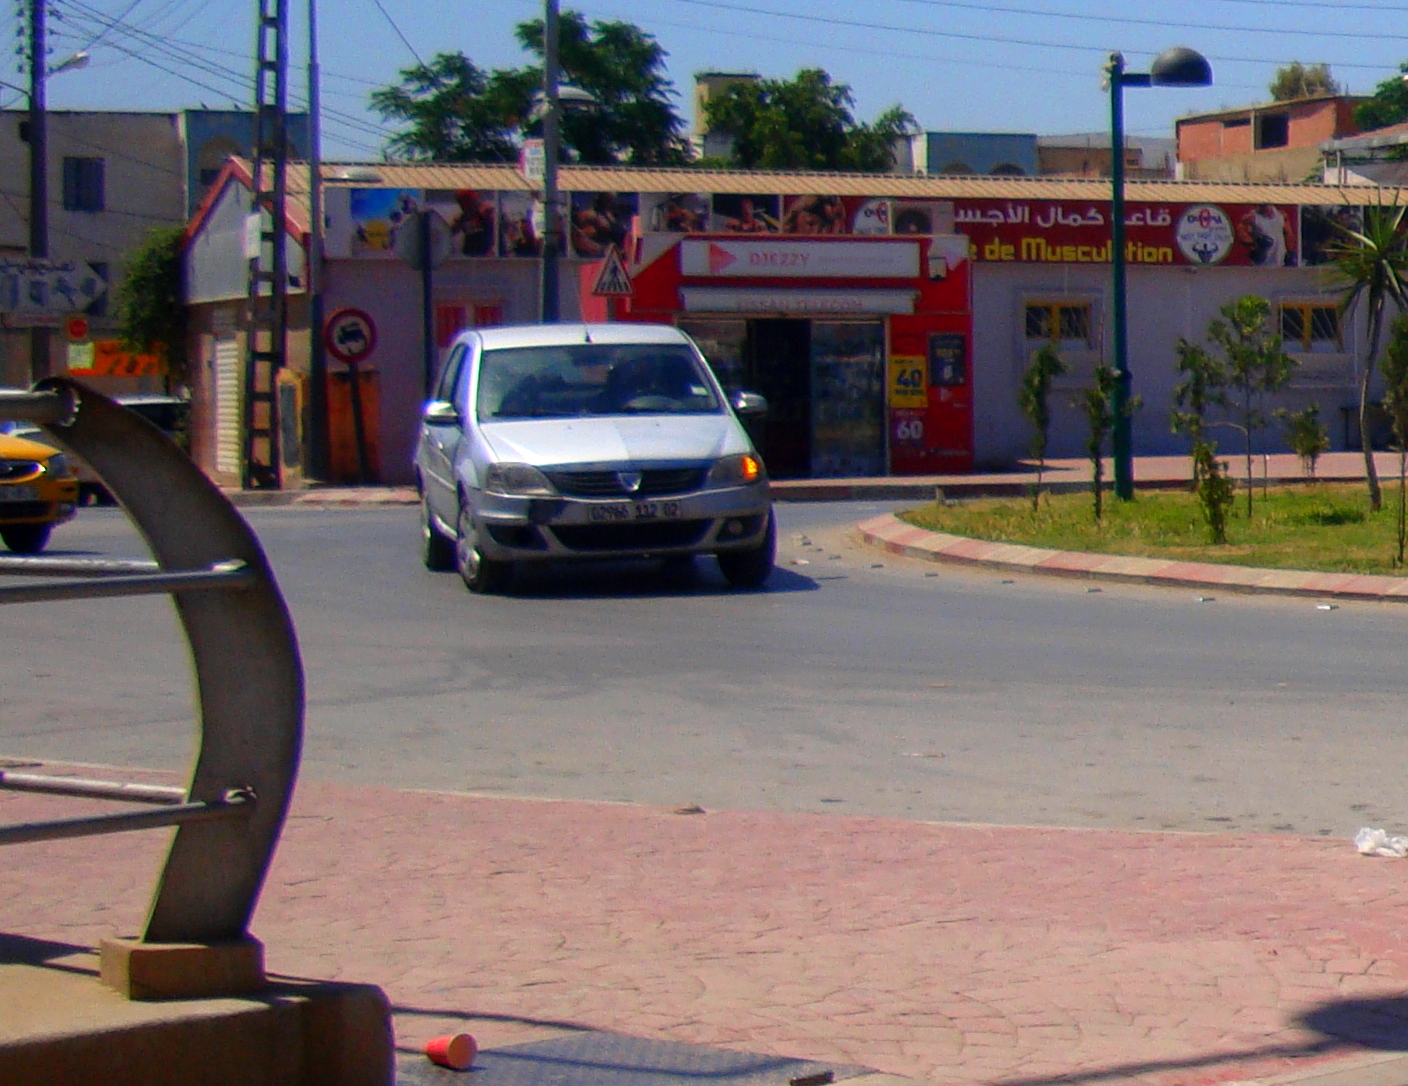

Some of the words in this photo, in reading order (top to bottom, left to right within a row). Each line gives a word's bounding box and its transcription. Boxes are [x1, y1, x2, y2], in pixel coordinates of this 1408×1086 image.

[954, 202, 1030, 227] الأجس
[1036, 205, 1105, 229] كمال
[1111, 205, 1172, 227] قاع
[984, 235, 1015, 261] de
[1021, 236, 1174, 263] Muscultion
[897, 420, 923, 440] 60
